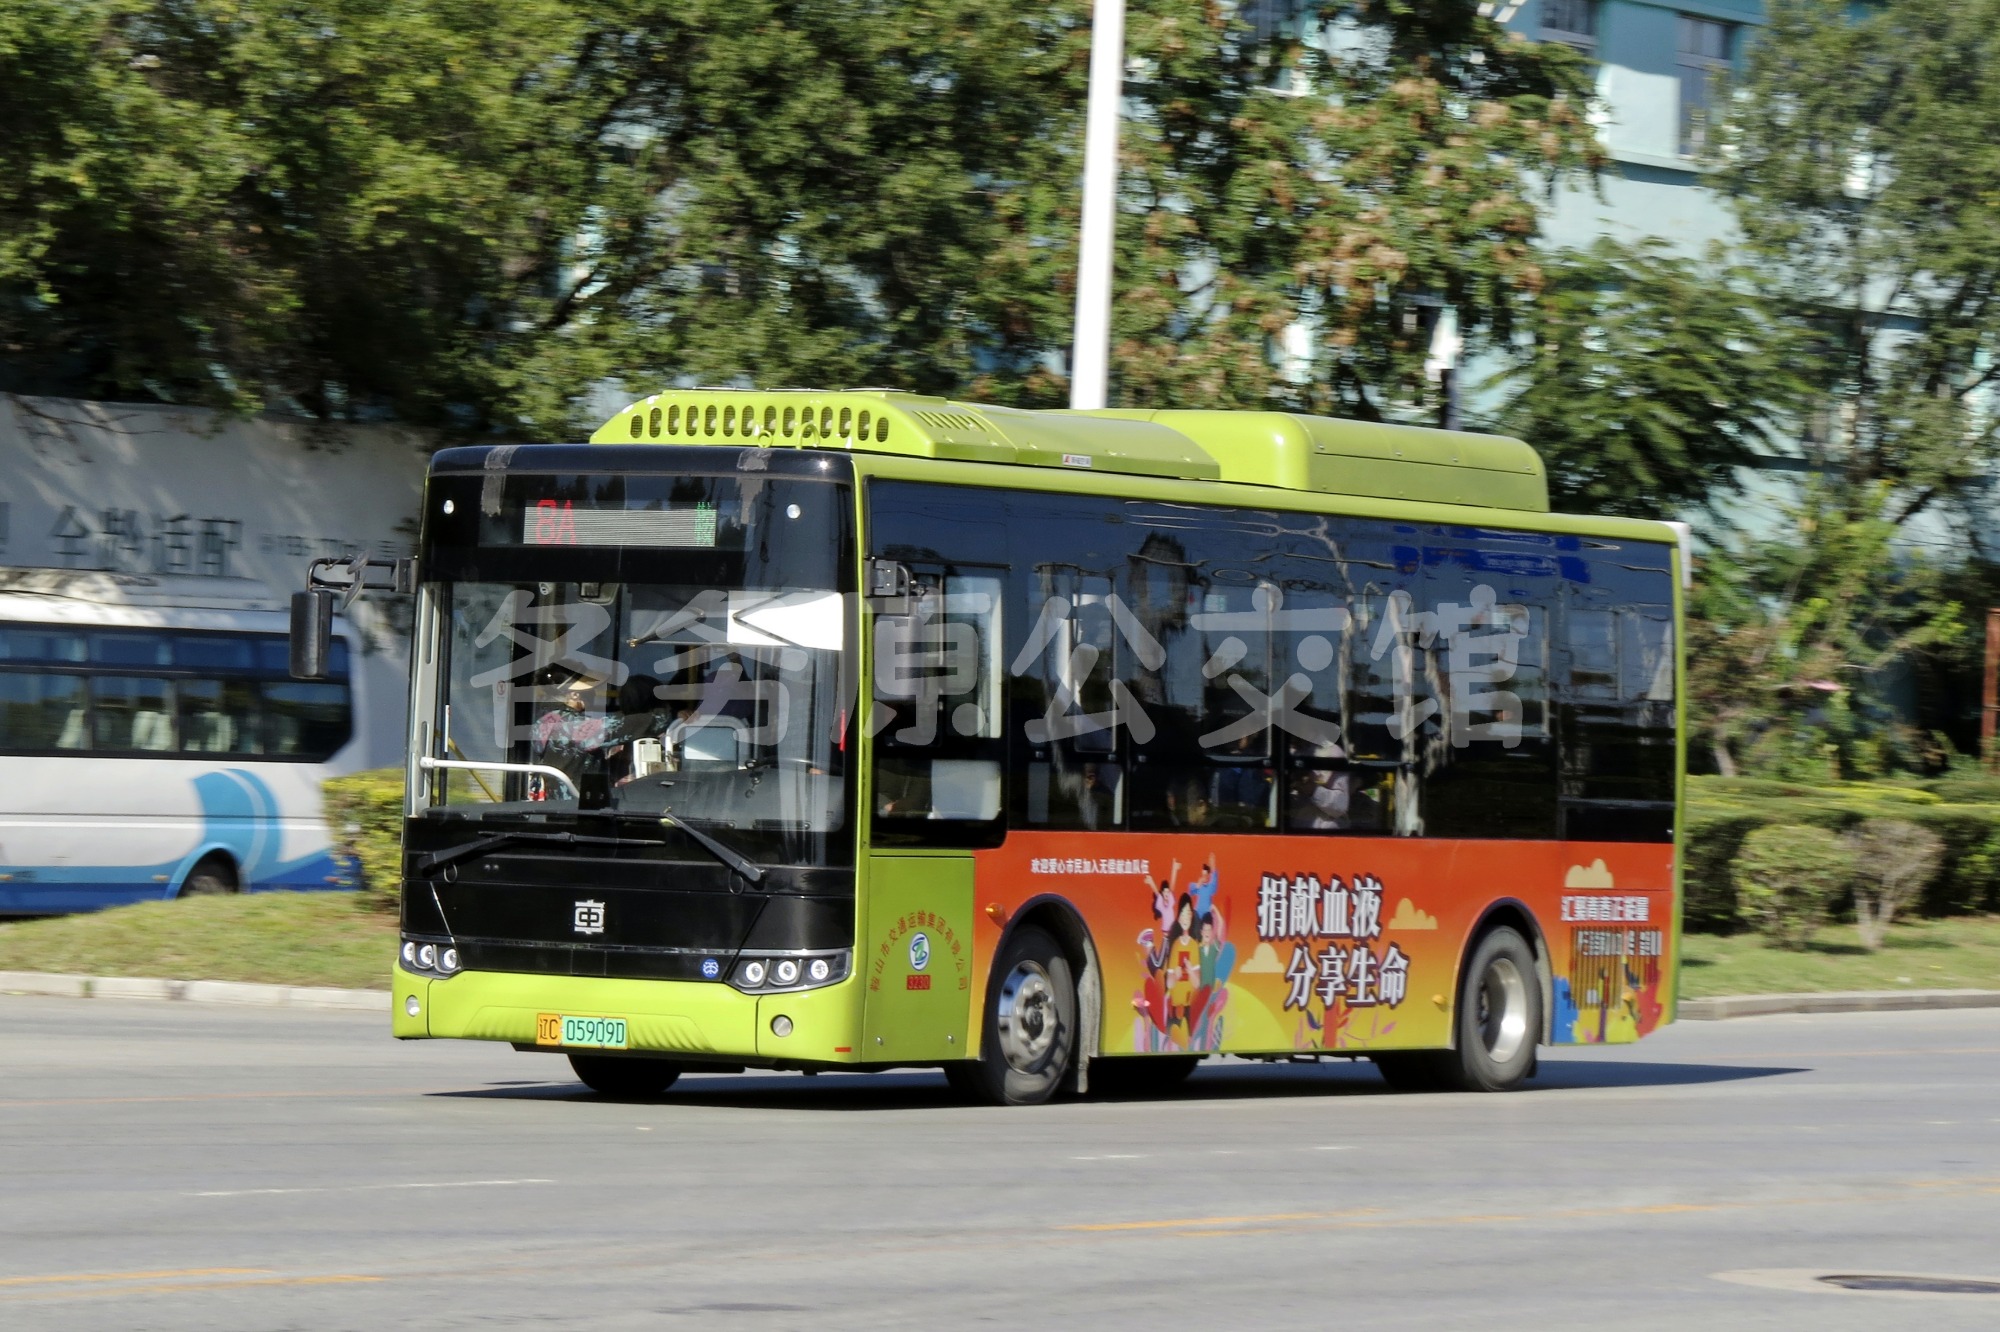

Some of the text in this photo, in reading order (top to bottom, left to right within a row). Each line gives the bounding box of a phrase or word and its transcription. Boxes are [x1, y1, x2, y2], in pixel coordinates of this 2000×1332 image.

[535, 499, 577, 546] 8A
[1257, 873, 1384, 940] 捐献血液
[1284, 943, 1409, 1009] 分享生命
